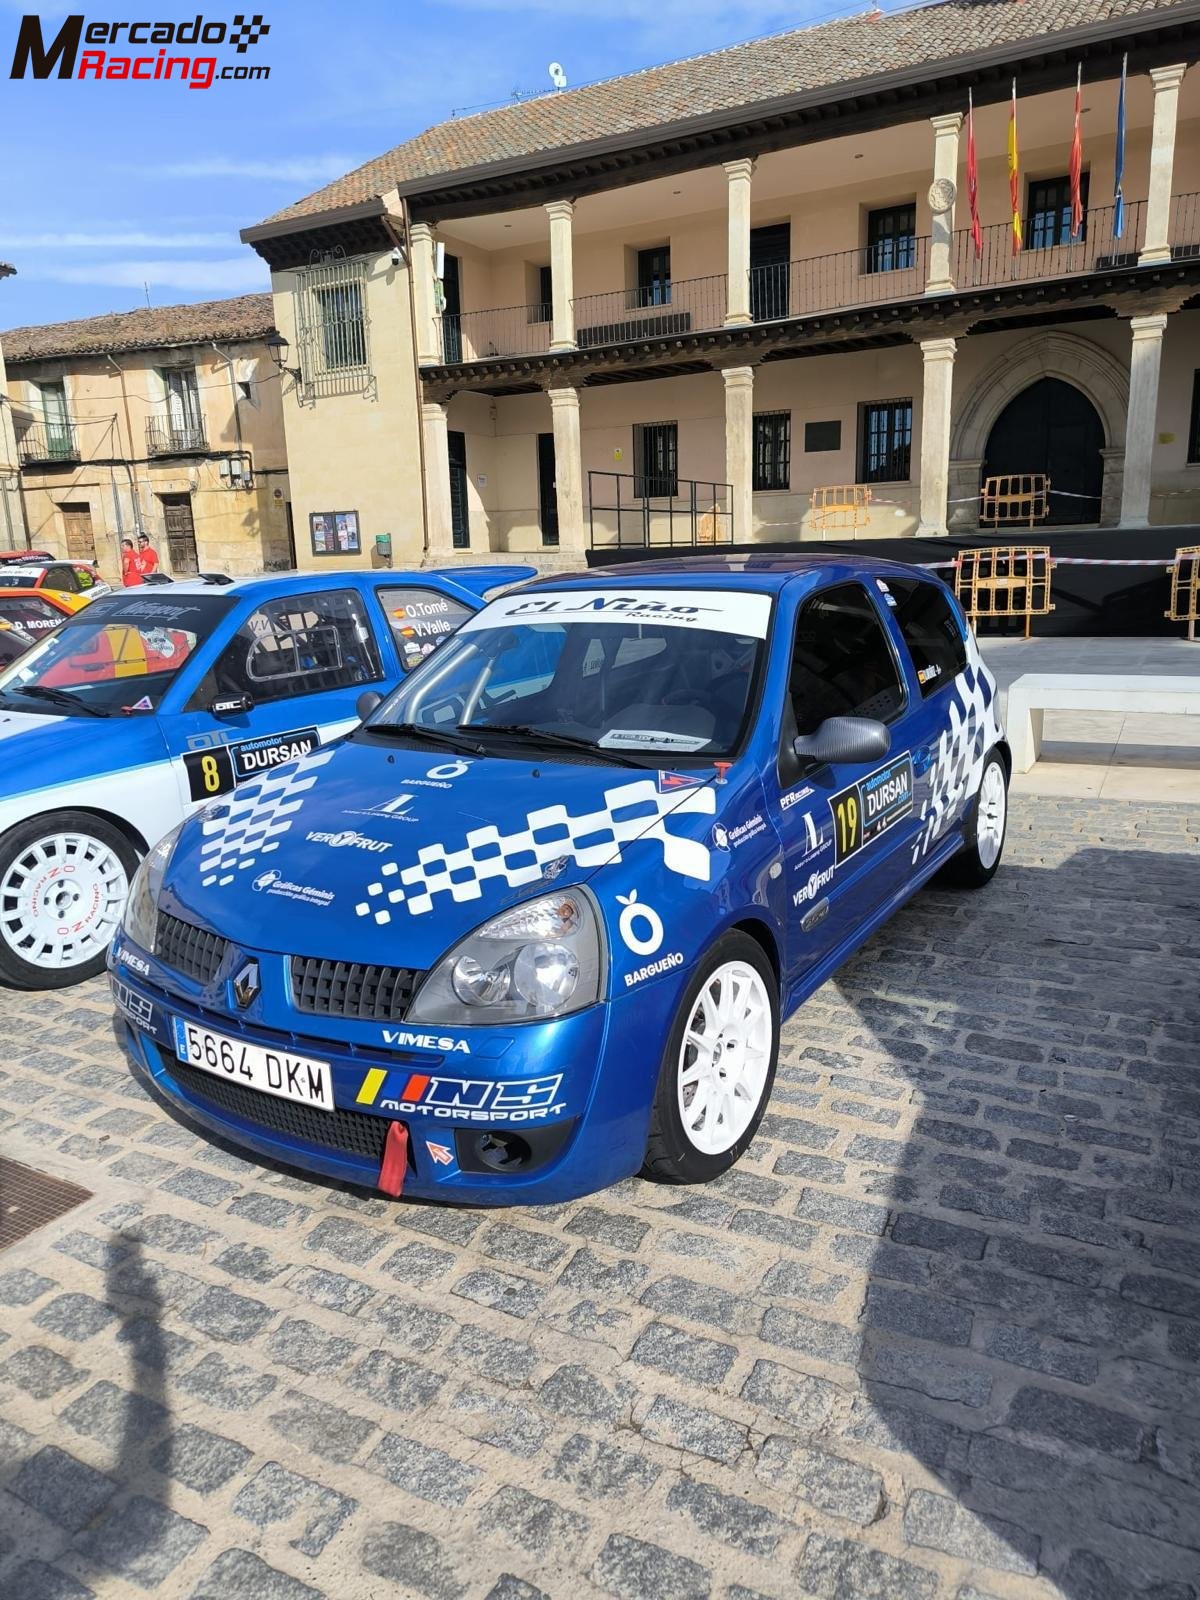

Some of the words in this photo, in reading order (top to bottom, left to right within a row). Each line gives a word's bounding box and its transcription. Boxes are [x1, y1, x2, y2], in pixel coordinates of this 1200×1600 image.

[406, 598, 448, 618] O.Tomé
[504, 601, 561, 616] El
[564, 597, 724, 613] Niño
[626, 611, 698, 622] Racing
[27, 617, 67, 629] MOREN
[413, 620, 451, 637] V.Valle
[240, 736, 284, 752] automotor
[241, 740, 312, 770] DURSAN
[201, 755, 220, 792] 8
[867, 771, 909, 817] DURSAN
[837, 797, 857, 854] 19
[117, 946, 150, 976] VIMESA
[624, 952, 684, 988] BARGUEÑO
[180, 1044, 187, 1054] E
[382, 1030, 471, 1054] VIMESA
[187, 1027, 254, 1081] 5664
[265, 1053, 325, 1103] DKM
[424, 1073, 564, 1109] NS
[380, 1099, 567, 1121] MOTORSPORT
